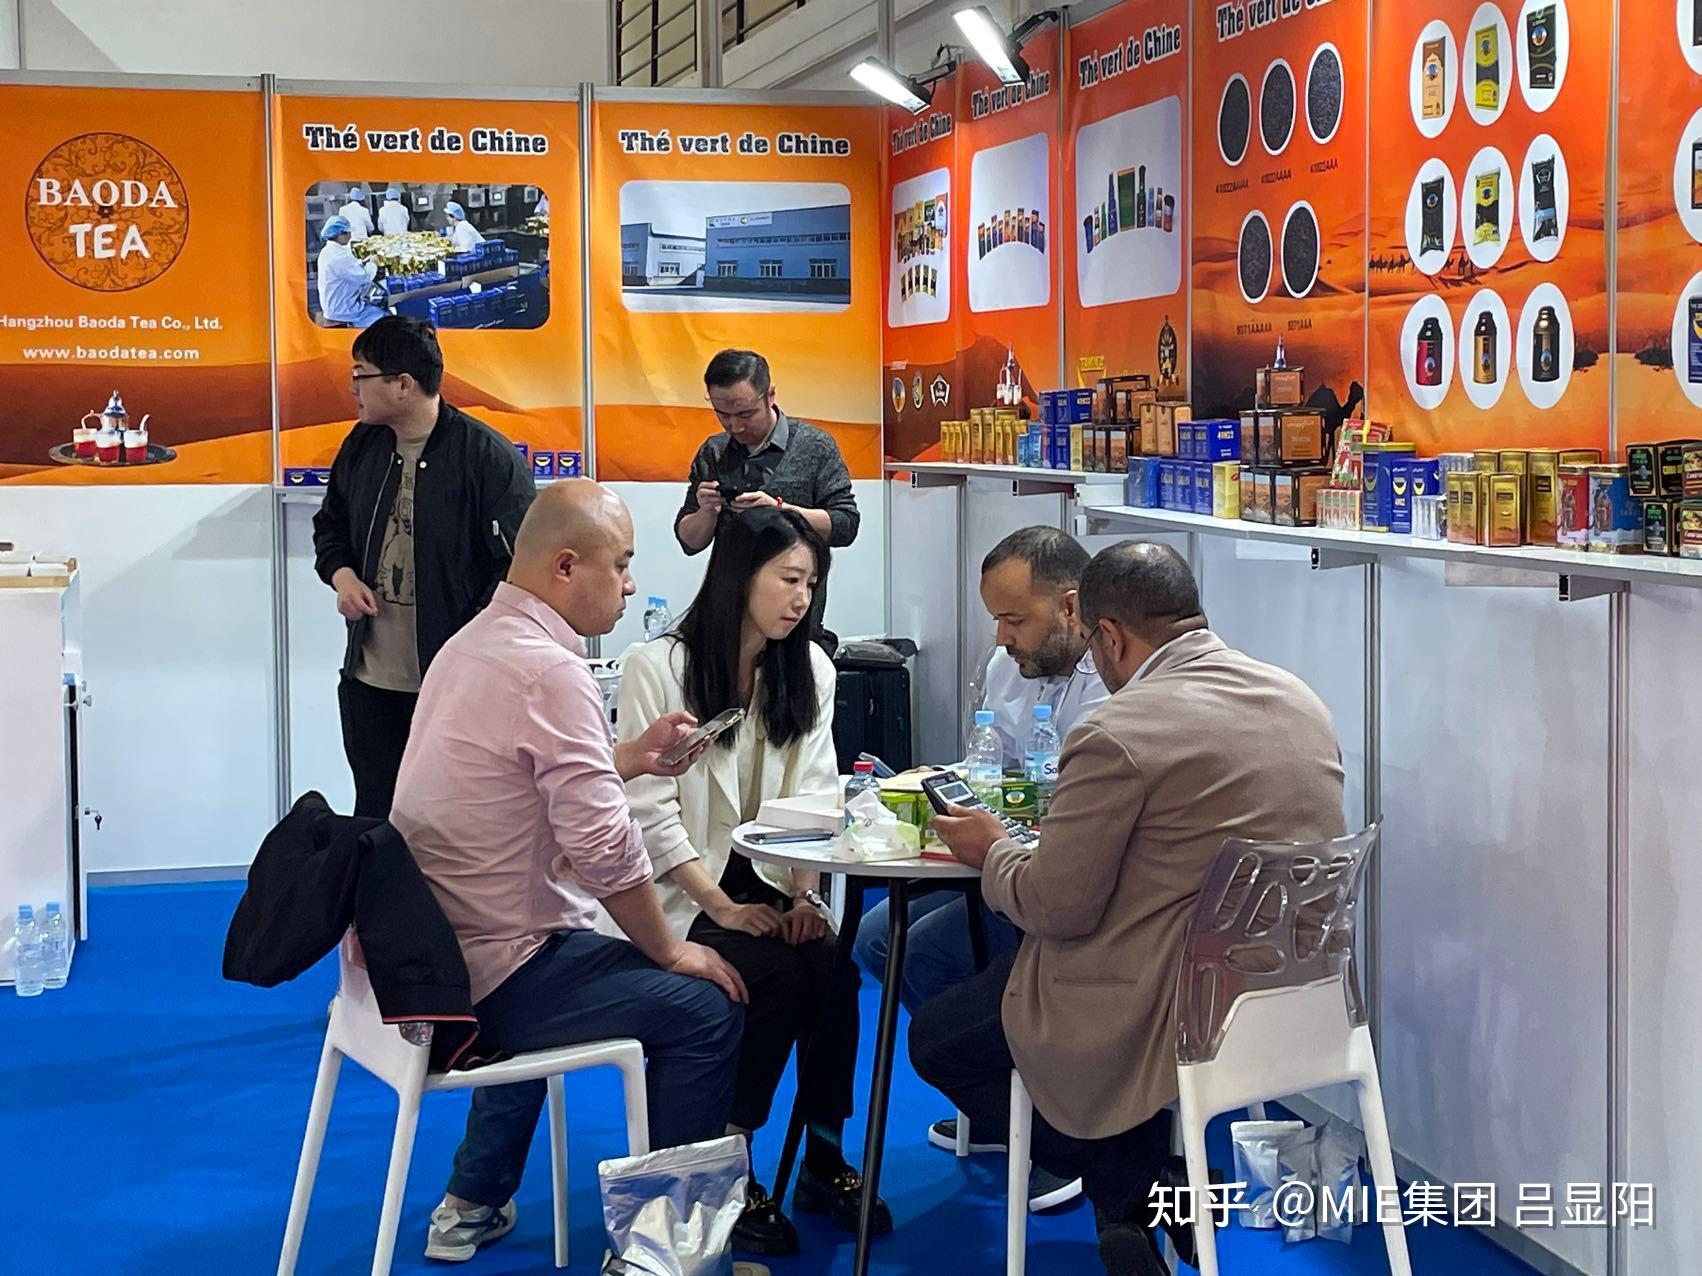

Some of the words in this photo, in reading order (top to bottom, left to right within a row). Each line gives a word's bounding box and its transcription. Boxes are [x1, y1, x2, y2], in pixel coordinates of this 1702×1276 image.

[1080, 51, 1099, 89] Thé
[1101, 43, 1122, 80] vert
[1127, 37, 1140, 71] de
[1144, 24, 1181, 63] Chine
[971, 87, 990, 119] Thé
[991, 86, 1008, 113] vert
[304, 124, 358, 150] Thé
[366, 129, 421, 152] vert
[429, 129, 462, 152] de
[471, 129, 548, 154] Chine
[619, 129, 671, 153] Thé
[679, 133, 730, 155] vert
[738, 133, 769, 154] de
[777, 133, 850, 156] Chine
[918, 118, 928, 146] de
[929, 111, 952, 141] Chine
[36, 178, 179, 208] BAODA
[69, 223, 151, 259] TEA
[78, 315, 125, 329] Baoda
[130, 316, 157, 329] Tea
[161, 316, 190, 331] Co.,
[195, 317, 223, 330] Ltd.
[23, 346, 200, 360] www.baodatea.com
